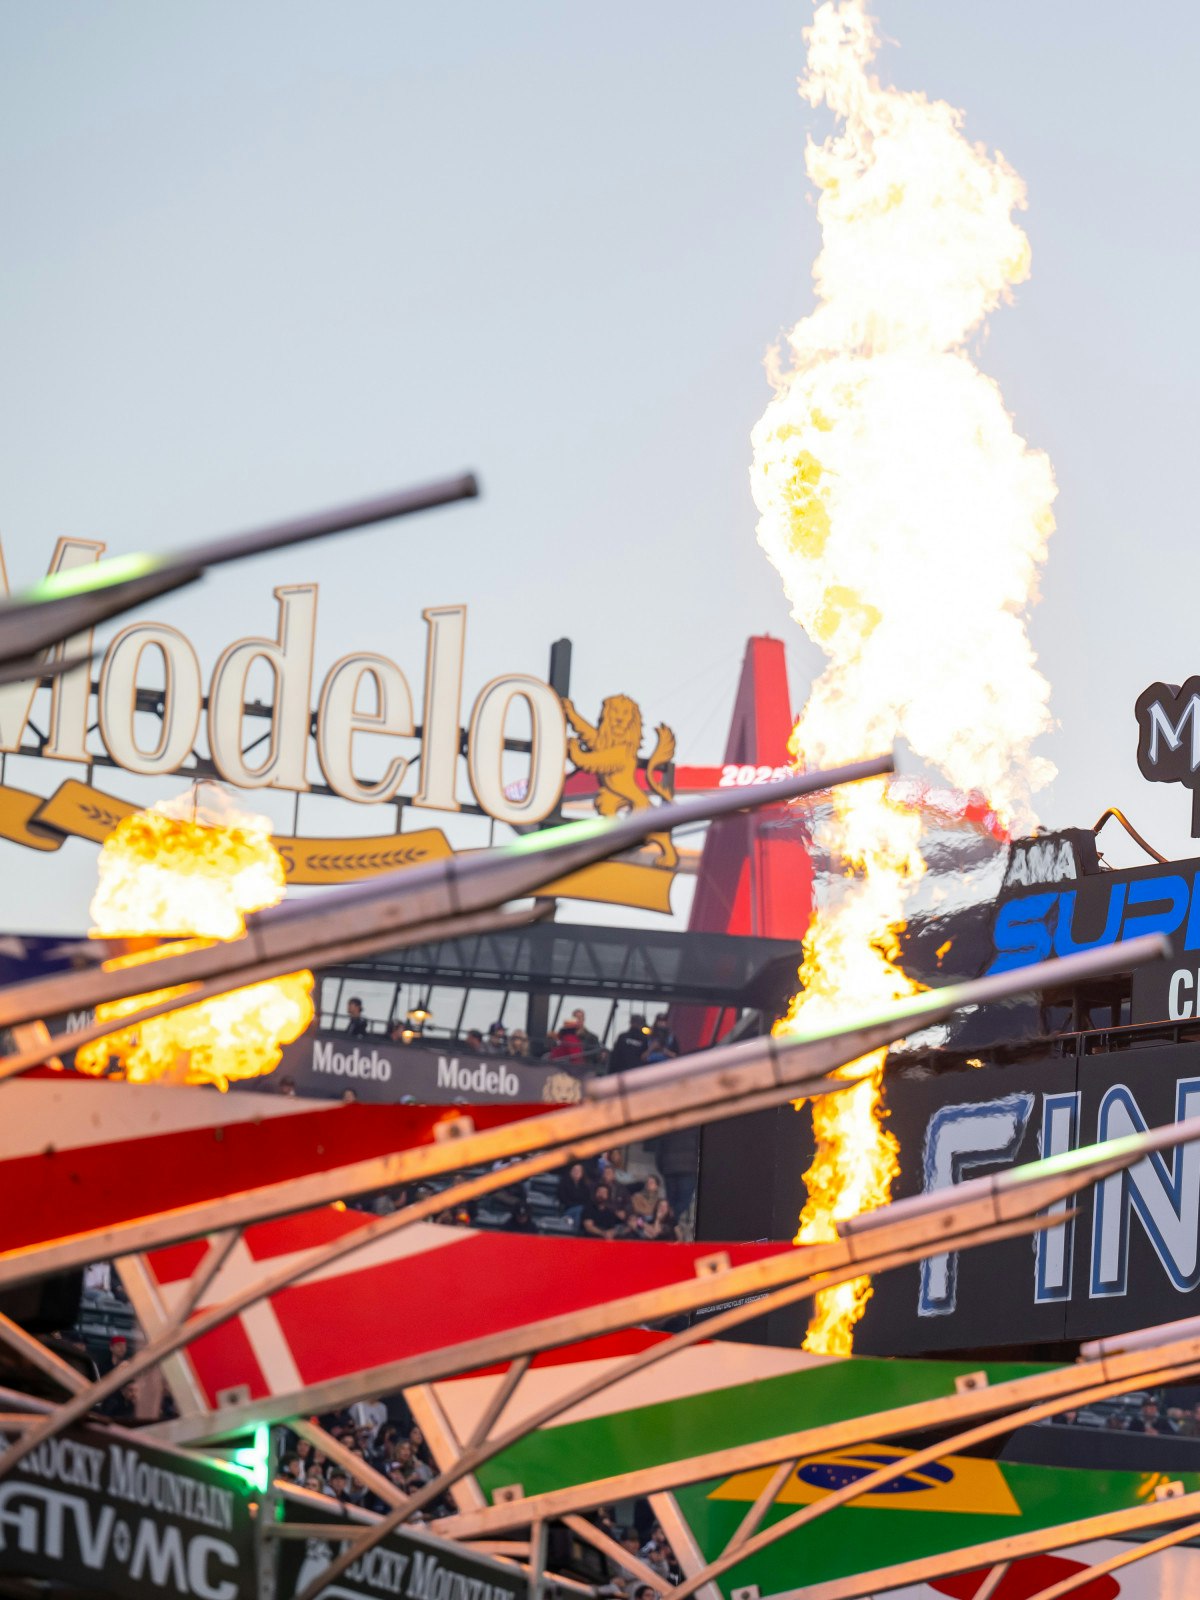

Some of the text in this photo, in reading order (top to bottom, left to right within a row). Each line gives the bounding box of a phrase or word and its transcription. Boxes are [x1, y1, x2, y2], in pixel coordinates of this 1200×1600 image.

[1004, 838, 1077, 887] AMA
[312, 1040, 391, 1082] Modelo
[437, 1056, 520, 1097] Modelo
[108, 1444, 234, 1531] MOUNTAIN
